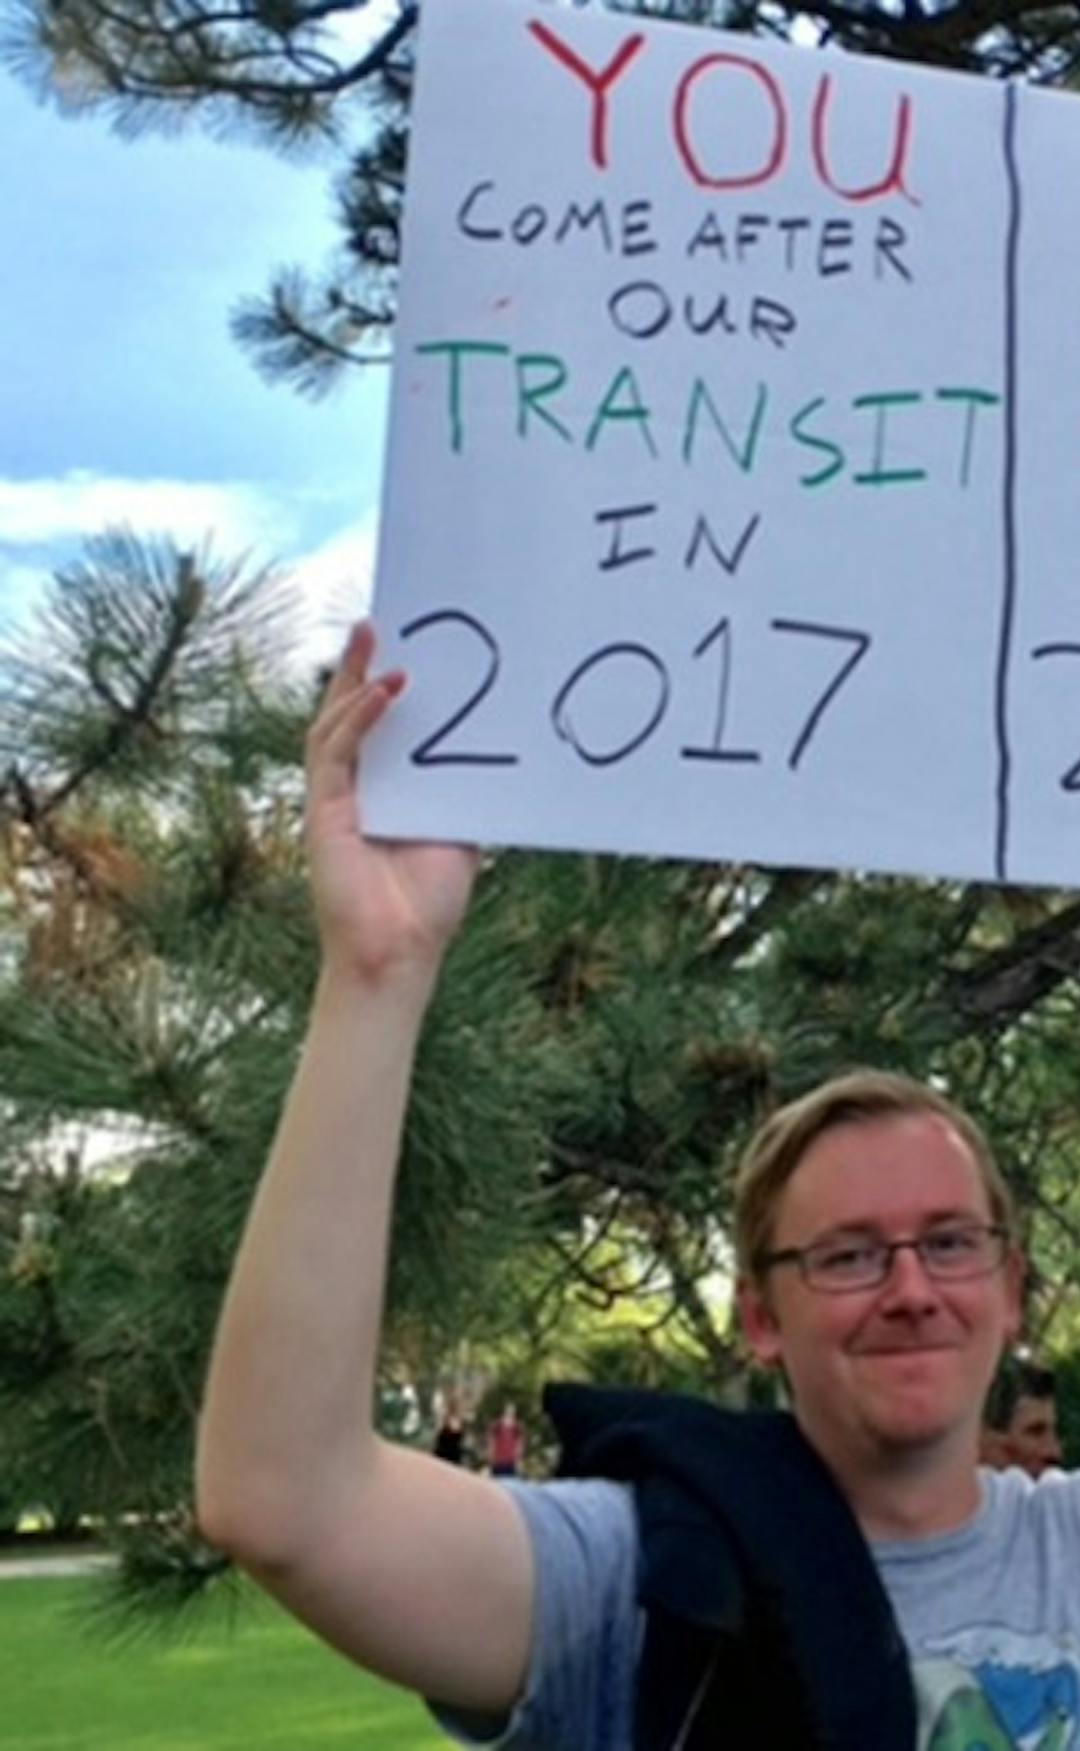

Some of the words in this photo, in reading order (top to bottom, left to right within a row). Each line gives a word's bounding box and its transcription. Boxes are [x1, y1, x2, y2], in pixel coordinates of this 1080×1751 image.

[528, 18, 923, 208] YOU
[457, 180, 659, 258] COME
[686, 211, 913, 282] AFTER
[606, 280, 798, 349] OUR
[414, 340, 1002, 489] TRANSIT
[593, 502, 762, 576] IN
[399, 609, 873, 772] 2017
